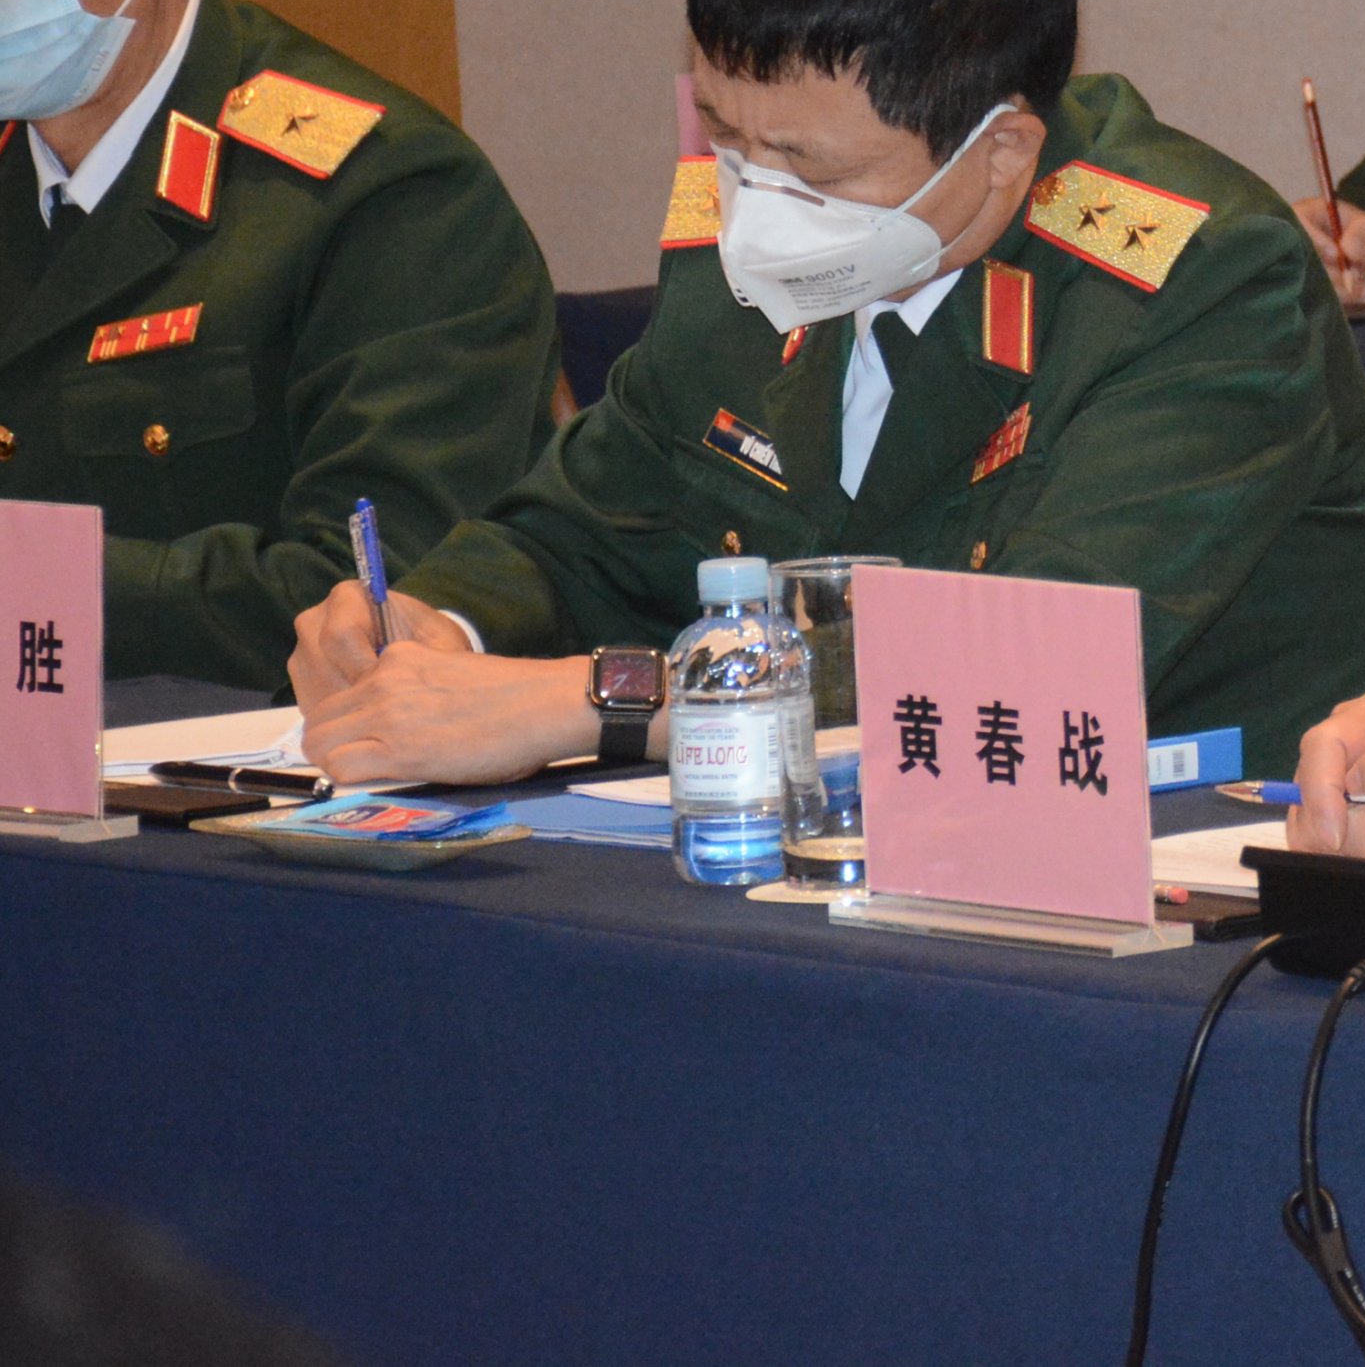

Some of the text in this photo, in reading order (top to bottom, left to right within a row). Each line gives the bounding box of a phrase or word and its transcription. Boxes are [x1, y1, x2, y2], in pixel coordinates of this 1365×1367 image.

[805, 264, 856, 283] 9001V
[16, 620, 65, 694] 胜
[892, 694, 1109, 796] 黄春战
